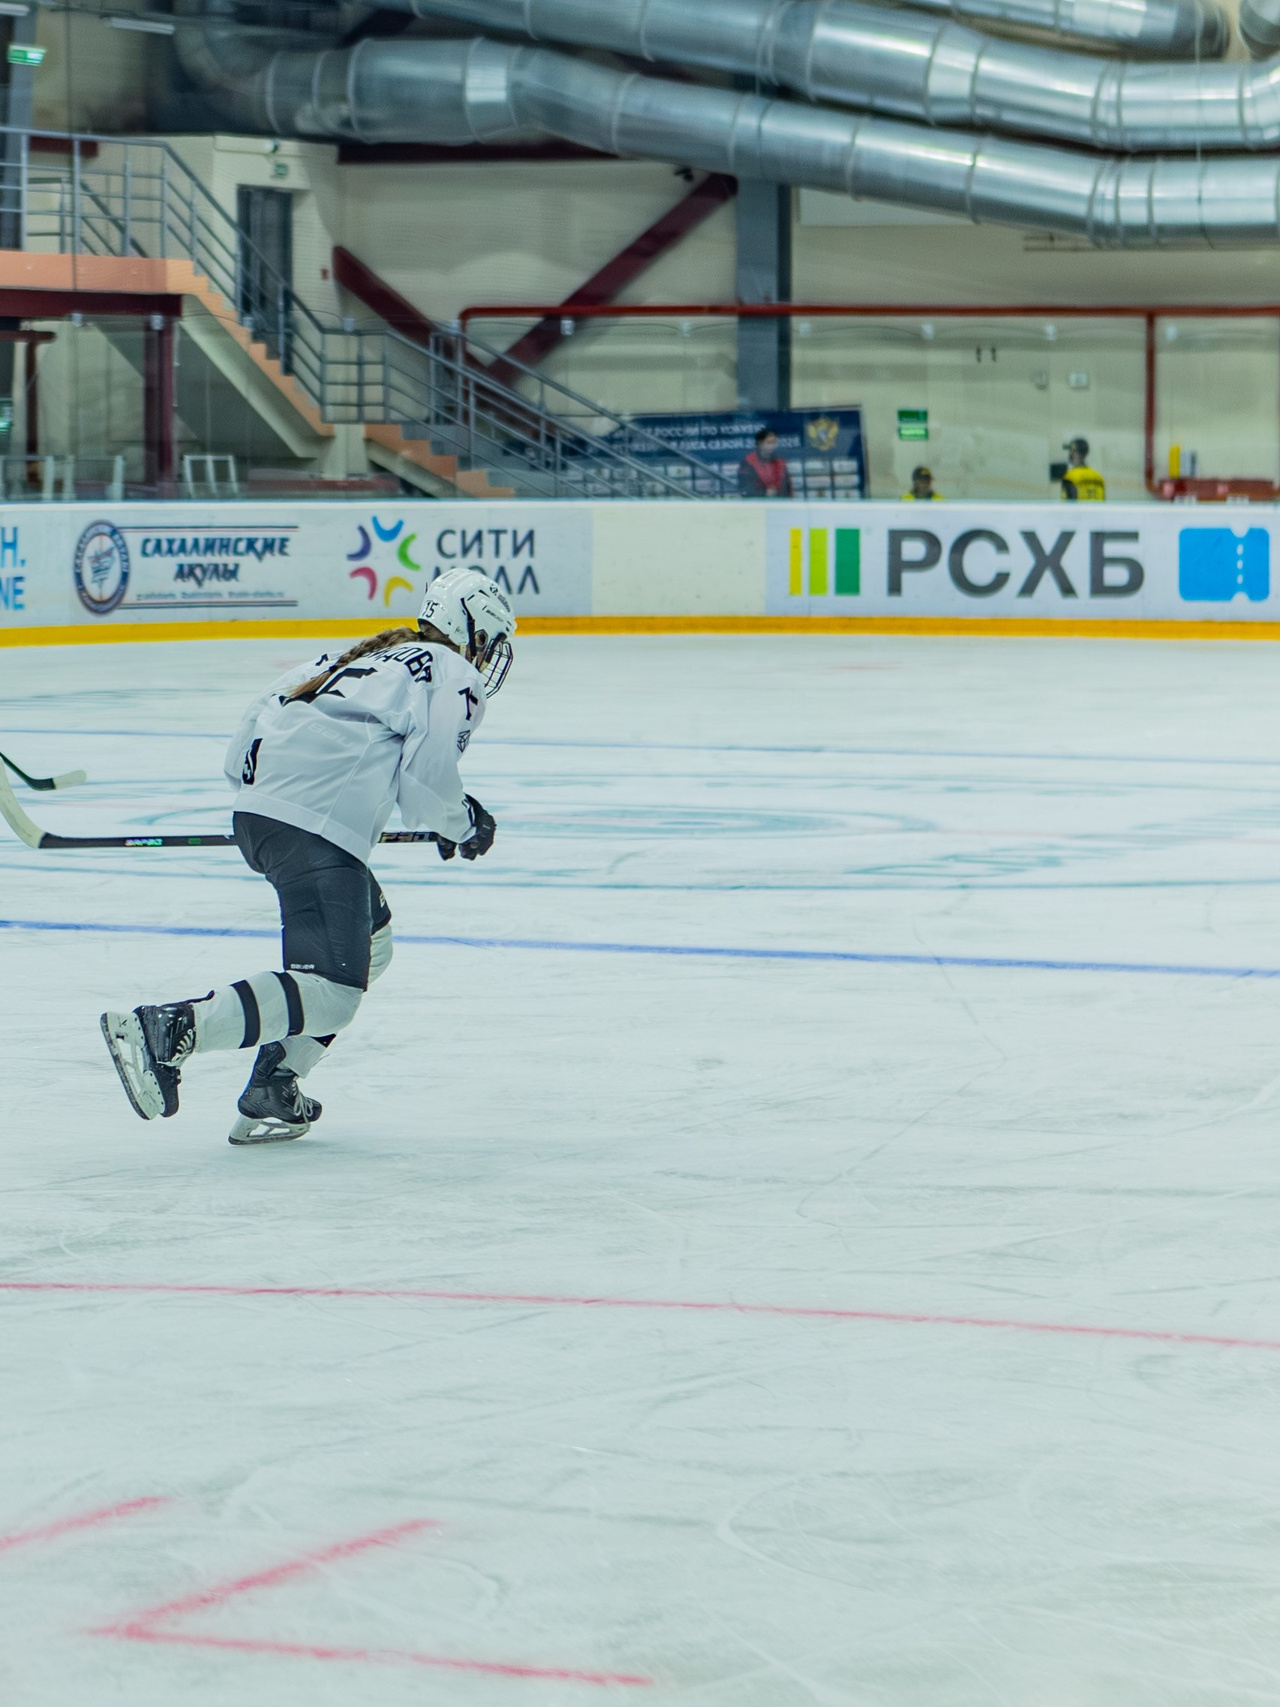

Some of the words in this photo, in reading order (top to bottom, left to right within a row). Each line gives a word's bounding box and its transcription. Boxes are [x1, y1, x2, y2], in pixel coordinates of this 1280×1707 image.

[140, 536, 291, 563] САХАЛИНСКИЕ
[436, 529, 535, 559] СИТИ
[174, 562, 240, 588] АКУЛЫ
[887, 529, 1145, 598] РСХБ
[421, 601, 440, 619] 15
